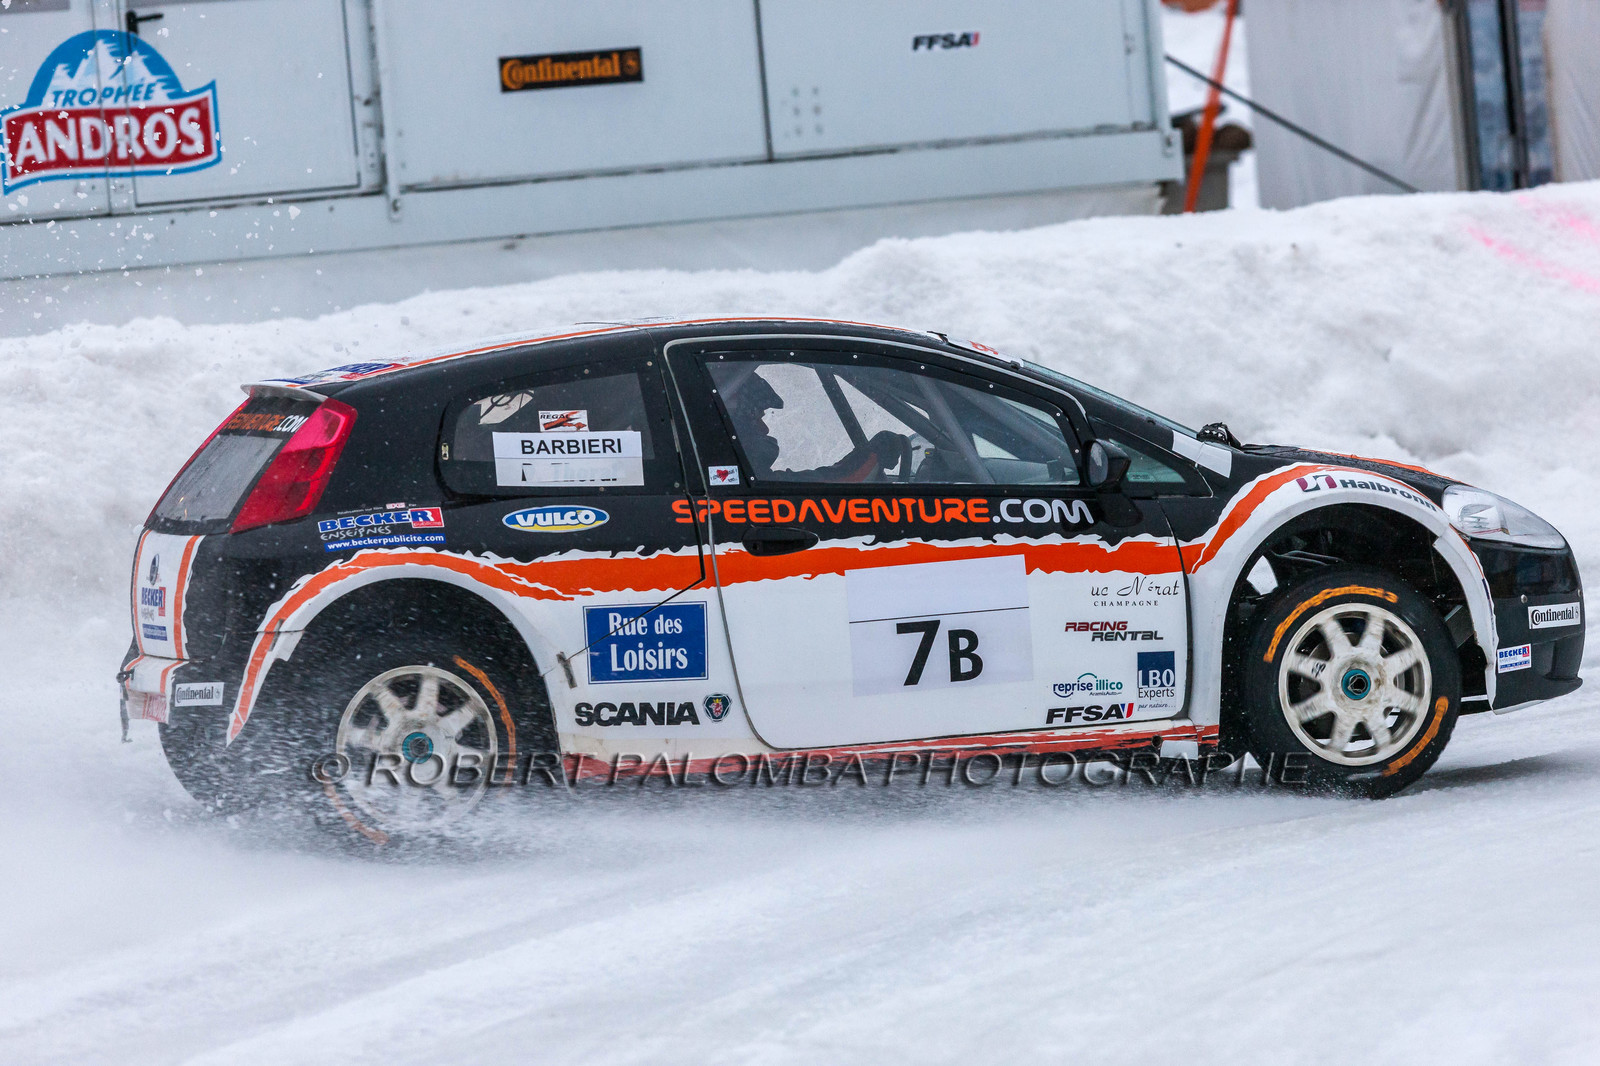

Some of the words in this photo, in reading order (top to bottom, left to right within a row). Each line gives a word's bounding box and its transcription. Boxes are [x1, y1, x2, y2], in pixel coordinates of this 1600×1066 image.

[912, 31, 972, 51] FFSA
[501, 52, 621, 90] Continental
[51, 78, 156, 107] TROPHÉE
[14, 107, 205, 166] ANDROS
[520, 438, 622, 455] BARBIERI
[1339, 479, 1438, 512] Halbronn
[318, 509, 436, 533] BECKER
[515, 509, 597, 528] VULCO
[671, 498, 1095, 524] SPEEDAVENTURE.COM
[327, 534, 445, 550] www.beckerpublicite.com
[608, 612, 648, 637] Rue
[654, 614, 683, 635] des
[1531, 606, 1575, 626] Continental
[610, 641, 689, 672] Loisirs
[1498, 647, 1528, 659] BECKER
[1053, 680, 1093, 694] reprise
[1095, 678, 1124, 691] illico
[1138, 669, 1175, 688] LBO
[1138, 687, 1175, 700] Experts
[574, 701, 701, 727] SCANIA
[1045, 703, 1126, 725] FFSA
